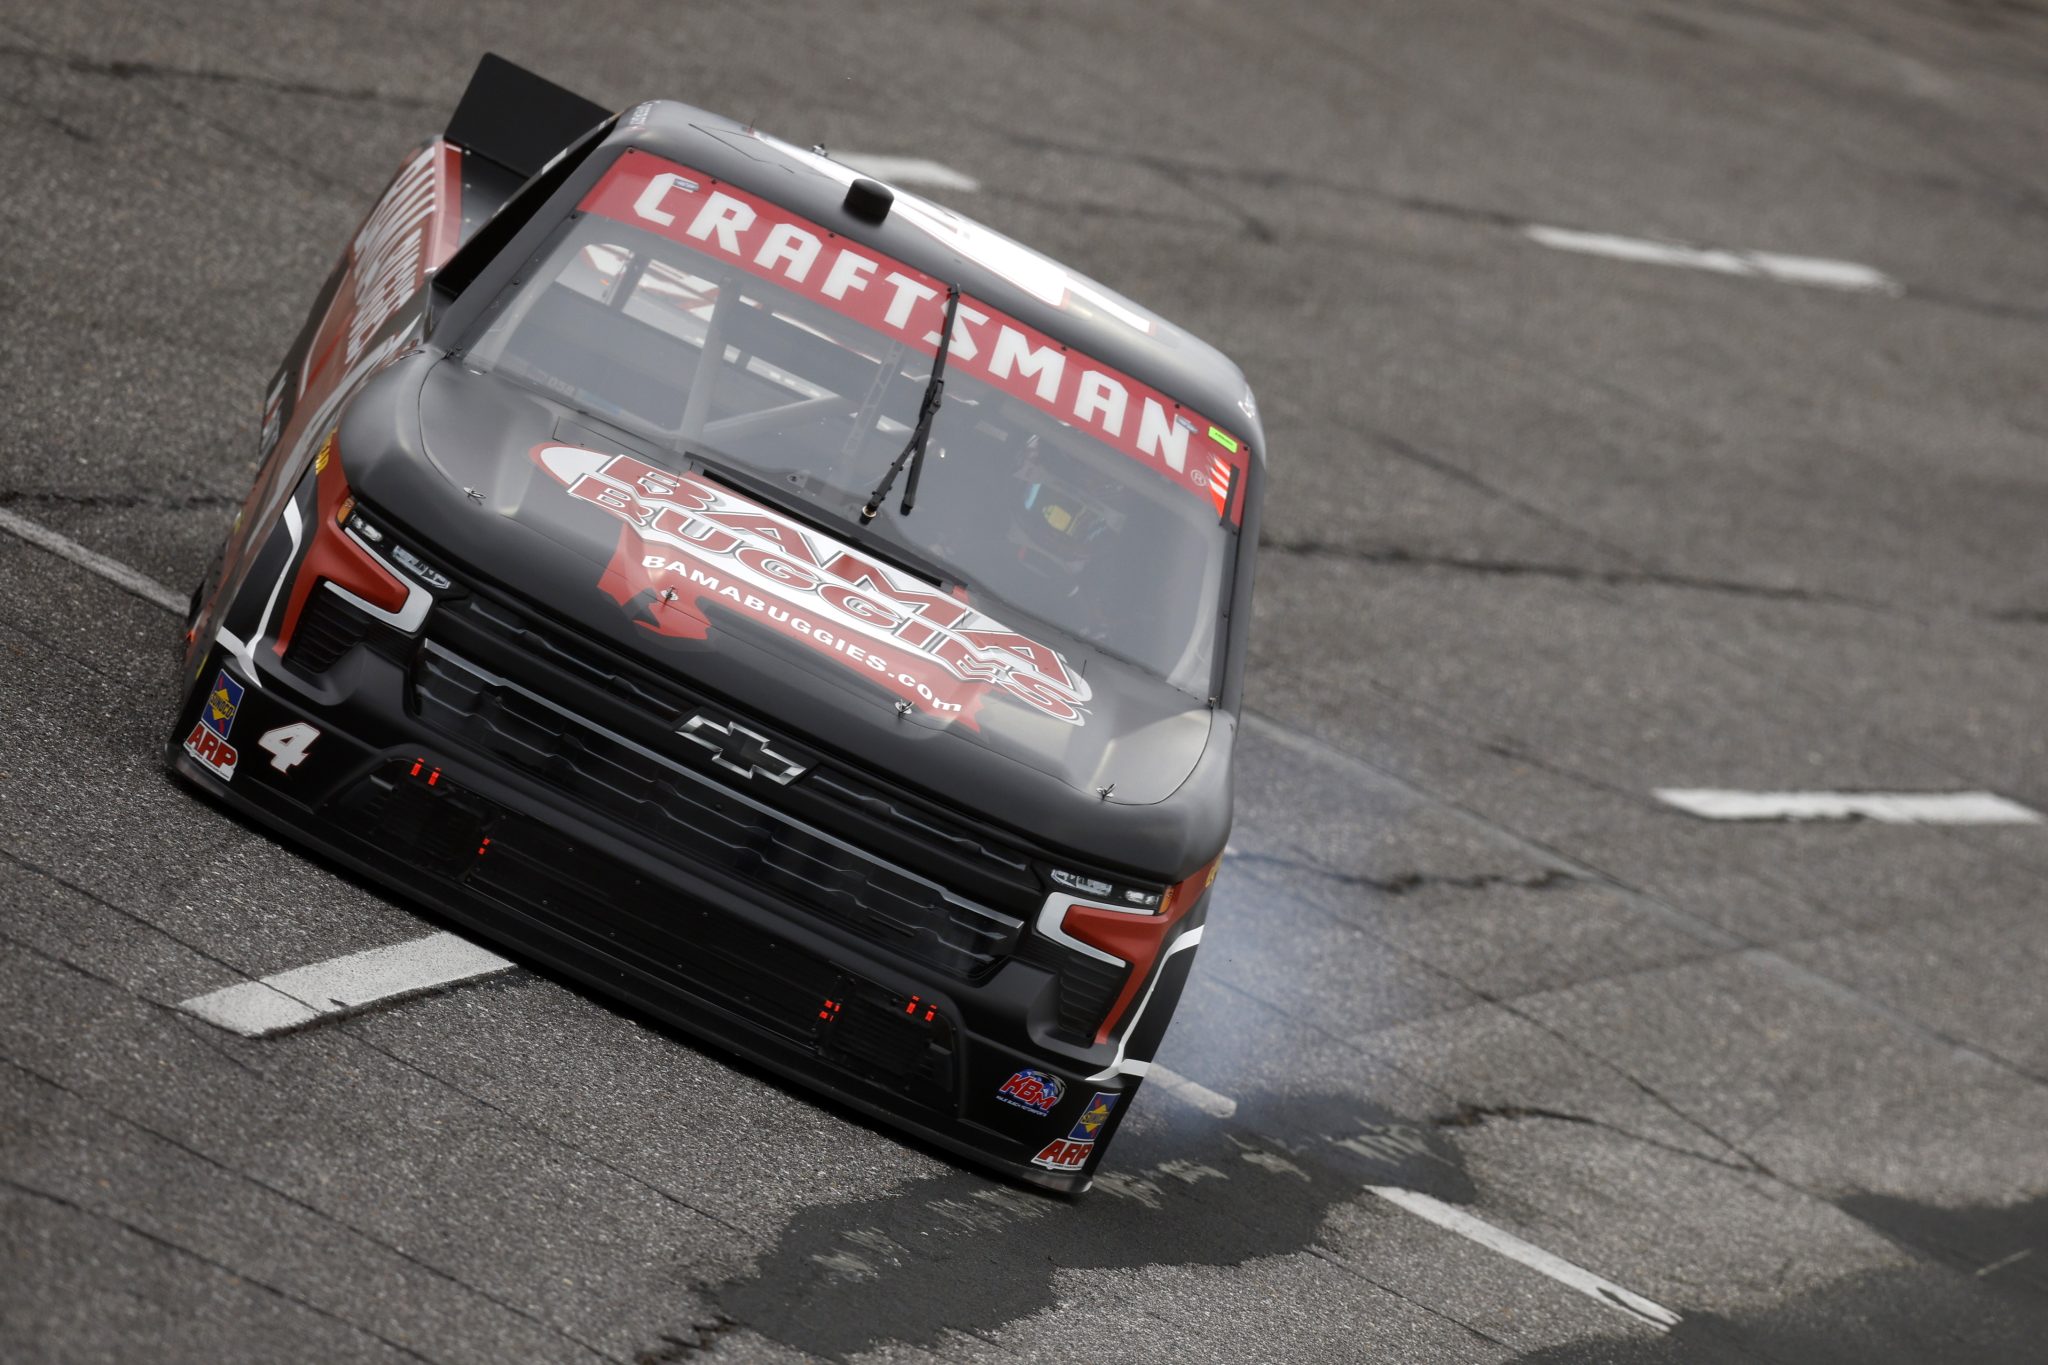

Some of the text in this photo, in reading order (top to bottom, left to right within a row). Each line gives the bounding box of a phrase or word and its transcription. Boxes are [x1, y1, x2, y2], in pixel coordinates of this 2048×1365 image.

[633, 172, 1191, 474] CRAFTSMAN
[567, 473, 1084, 719] BUGGIES
[597, 454, 1075, 689] BAMA
[186, 725, 237, 768] ARP
[258, 722, 320, 774] 4
[999, 1073, 1058, 1110] KBM
[1035, 1140, 1095, 1166] ARP
